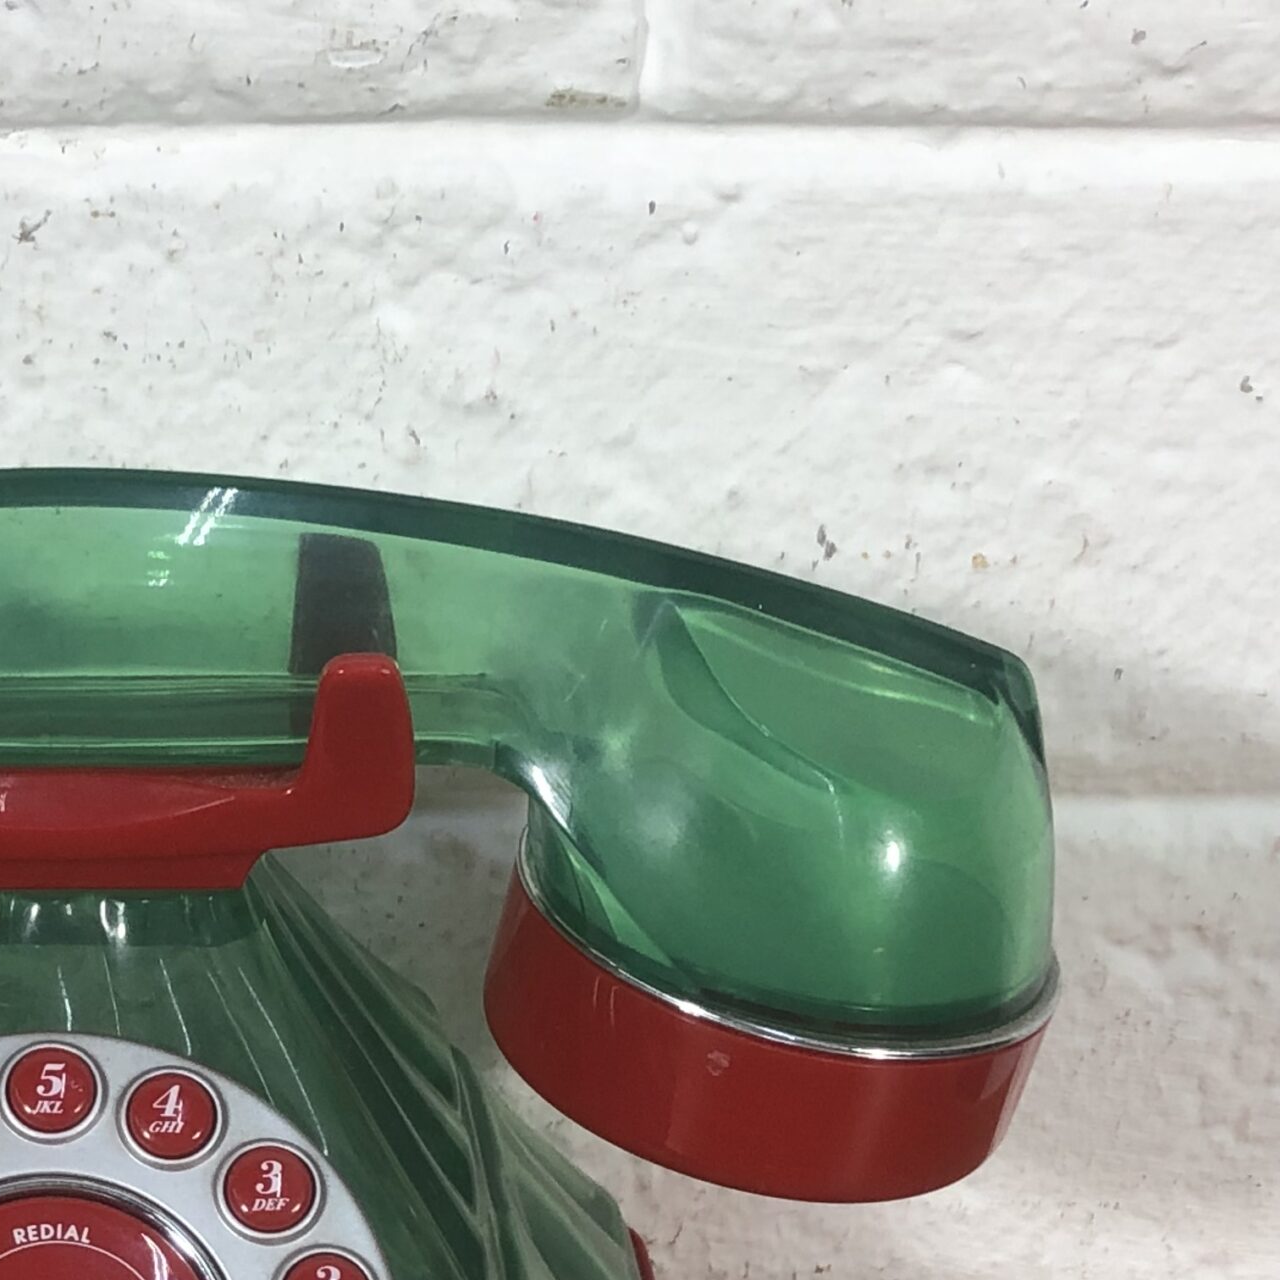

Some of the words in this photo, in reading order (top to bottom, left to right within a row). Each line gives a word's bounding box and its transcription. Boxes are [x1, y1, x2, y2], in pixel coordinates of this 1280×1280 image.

[36, 1063, 65, 1097] 5
[33, 1101, 64, 1114] JKL
[153, 1085, 182, 1118] 4
[255, 1160, 282, 1195] 3
[252, 1198, 289, 1212] DEF
[12, 1223, 91, 1245] REDIAL
